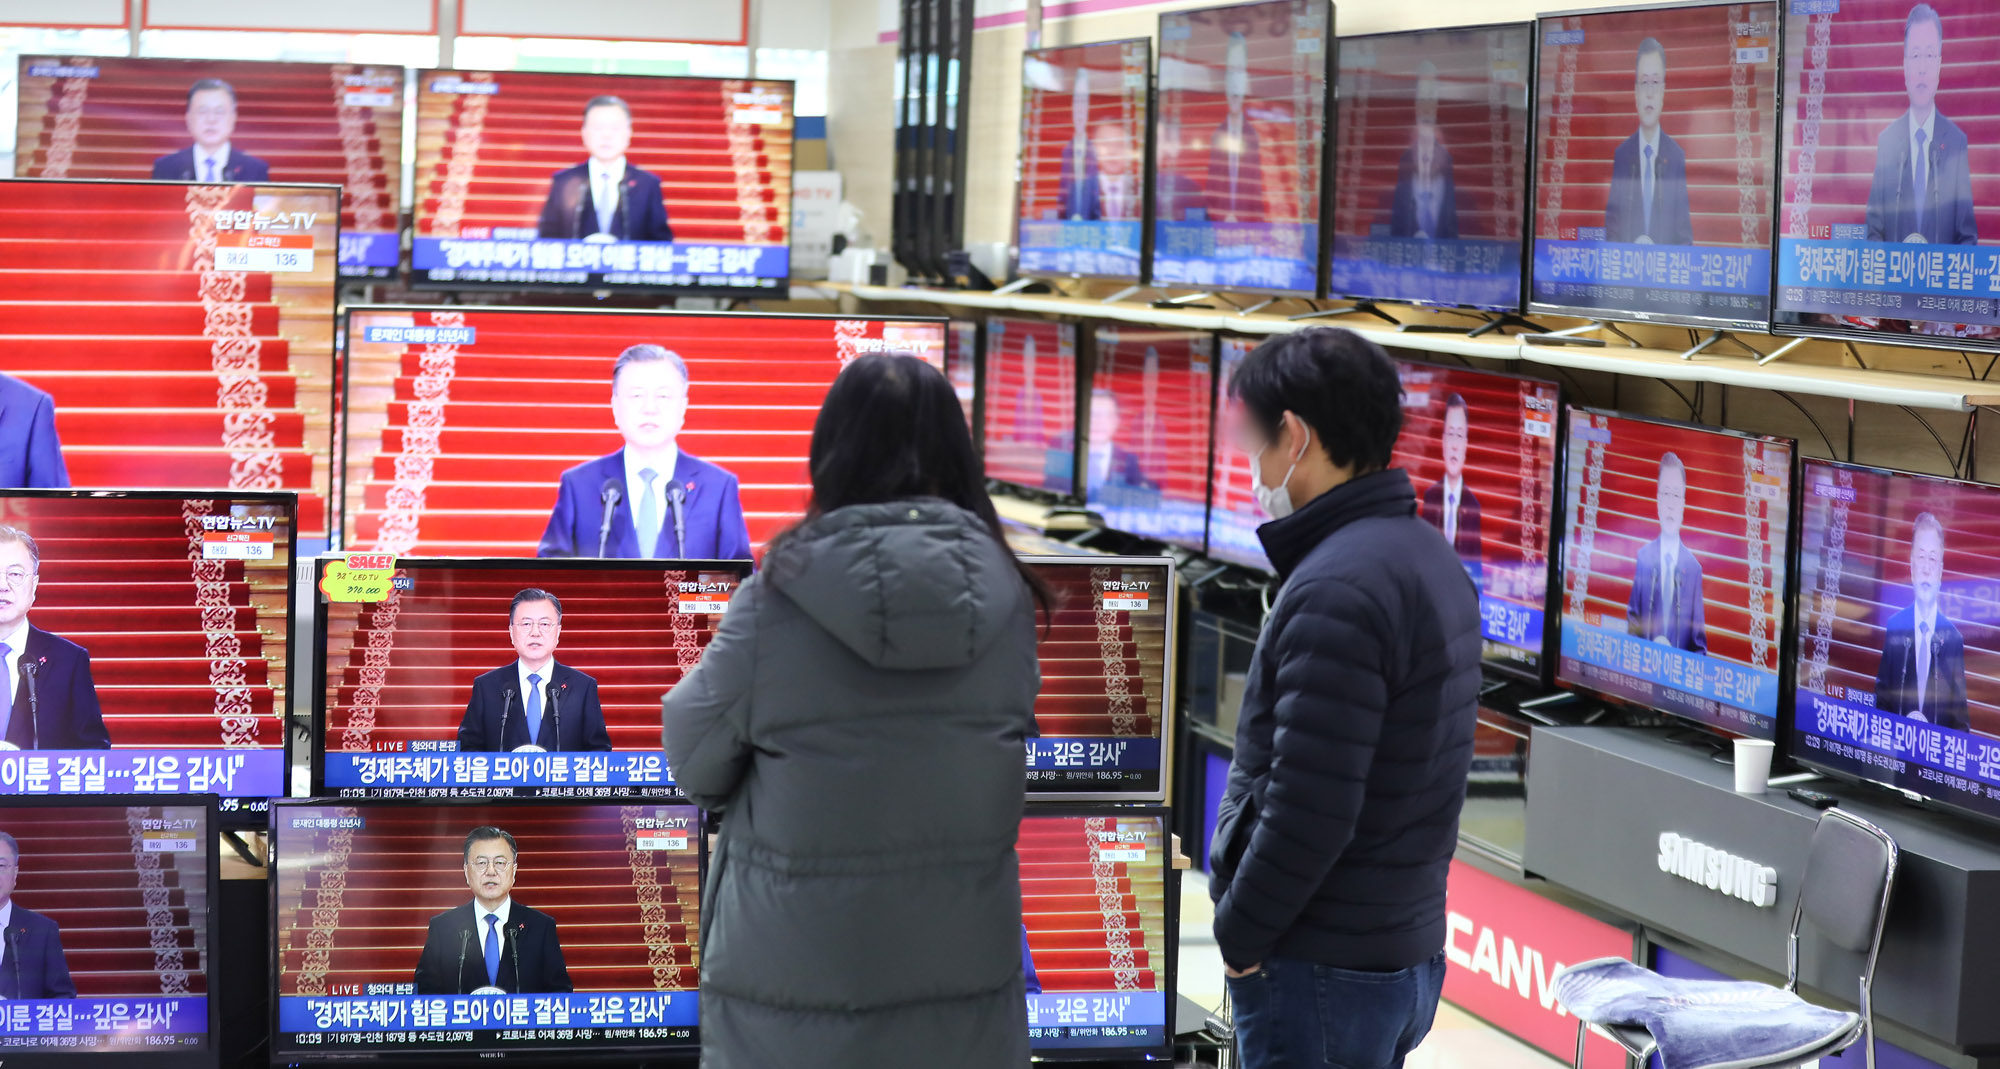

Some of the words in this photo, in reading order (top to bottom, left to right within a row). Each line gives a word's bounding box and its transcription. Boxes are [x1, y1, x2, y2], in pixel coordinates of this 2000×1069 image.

[214, 210, 317, 231] 연합뉴스TV
[1811, 225, 1830, 237] LIVE
[227, 252, 249, 265] 해외
[275, 253, 297, 266] 136
[1601, 249, 1621, 280] 힘을
[1623, 251, 1645, 282] 모아
[1646, 251, 1667, 283] 이룬
[1795, 244, 1860, 283] "경제주체가
[1861, 248, 1887, 286] 힘을
[1888, 249, 1916, 288] 모아
[1917, 251, 1944, 288] 이룬
[202, 515, 275, 531] 연합뉴스TV
[227, 534, 250, 543] 신규확진
[212, 545, 227, 556] 해외
[246, 546, 262, 556] 136
[348, 555, 393, 570] SALE!
[678, 582, 730, 593] 연합뉴스TV
[1103, 580, 1150, 591] 연합뉴스TV
[1507, 610, 1530, 644] 감사"
[1622, 640, 1641, 673] 힘을
[1642, 646, 1662, 680] 모아
[1663, 652, 1682, 685] 이룬
[1735, 671, 1760, 707] 감사"
[1827, 684, 1844, 699] LIVE
[1813, 696, 1869, 744] "경제주체가
[1870, 714, 1893, 751] 힘을
[1893, 721, 1917, 758] 모아
[1918, 729, 1942, 764] 이룬
[376, 742, 403, 751] LIVE
[411, 741, 437, 752] 청와대
[438, 741, 457, 752] 본관
[1089, 741, 1126, 767] 감사"
[1, 756, 52, 793] 이룬
[186, 754, 244, 792] 감사"
[352, 756, 450, 784] "경제주체가
[453, 756, 490, 783] 힘을
[492, 756, 530, 783] 모아
[533, 756, 569, 783] 이룬
[1096, 771, 1122, 780] 186.95
[340, 788, 365, 798] 10:09
[427, 788, 447, 798] 187명
[450, 788, 458, 798] 등
[460, 788, 485, 798] 수도권
[542, 787, 575, 797] 코로나로
[576, 787, 593, 797] 어제
[594, 787, 611, 797] 36명
[142, 818, 197, 830] 연합뉴스TV
[292, 818, 315, 828] 문재인
[316, 818, 338, 828] 대통령
[339, 817, 361, 828] 신년사
[635, 818, 688, 829] 연합뉴스TV
[1098, 832, 1146, 842] 연합뉴스TV
[1658, 832, 1777, 907] SAMSUNG
[1446, 911, 1567, 1017] CANV
[332, 985, 359, 995] LIVE
[367, 984, 394, 995] 청와대
[395, 984, 414, 995] 본관
[307, 999, 407, 1029] "경제주체가
[411, 999, 448, 1027] 힘을
[451, 998, 489, 1026] 모아
[493, 998, 530, 1025] 이룬
[628, 995, 672, 1023] 감사"
[1092, 996, 1130, 1022] 감사"
[0, 1004, 31, 1031] 이룬
[134, 1001, 178, 1030] 감사"
[296, 1033, 322, 1044] 10:09
[385, 1032, 406, 1042] 187명
[408, 1032, 417, 1042] 등
[418, 1032, 445, 1042] 수도권
[446, 1031, 473, 1042] 2,097명
[502, 1030, 536, 1041] 코로나로
[538, 1030, 555, 1040] 어제
[556, 1030, 573, 1040] 36명
[638, 1029, 667, 1039] 186.95
[1101, 1027, 1127, 1036] 186.95
[3, 1037, 38, 1047] 코로나로
[41, 1036, 58, 1047] 어제
[59, 1036, 77, 1046] 36명
[145, 1035, 175, 1045] 186.95
[184, 1037, 198, 1045] 0.00
